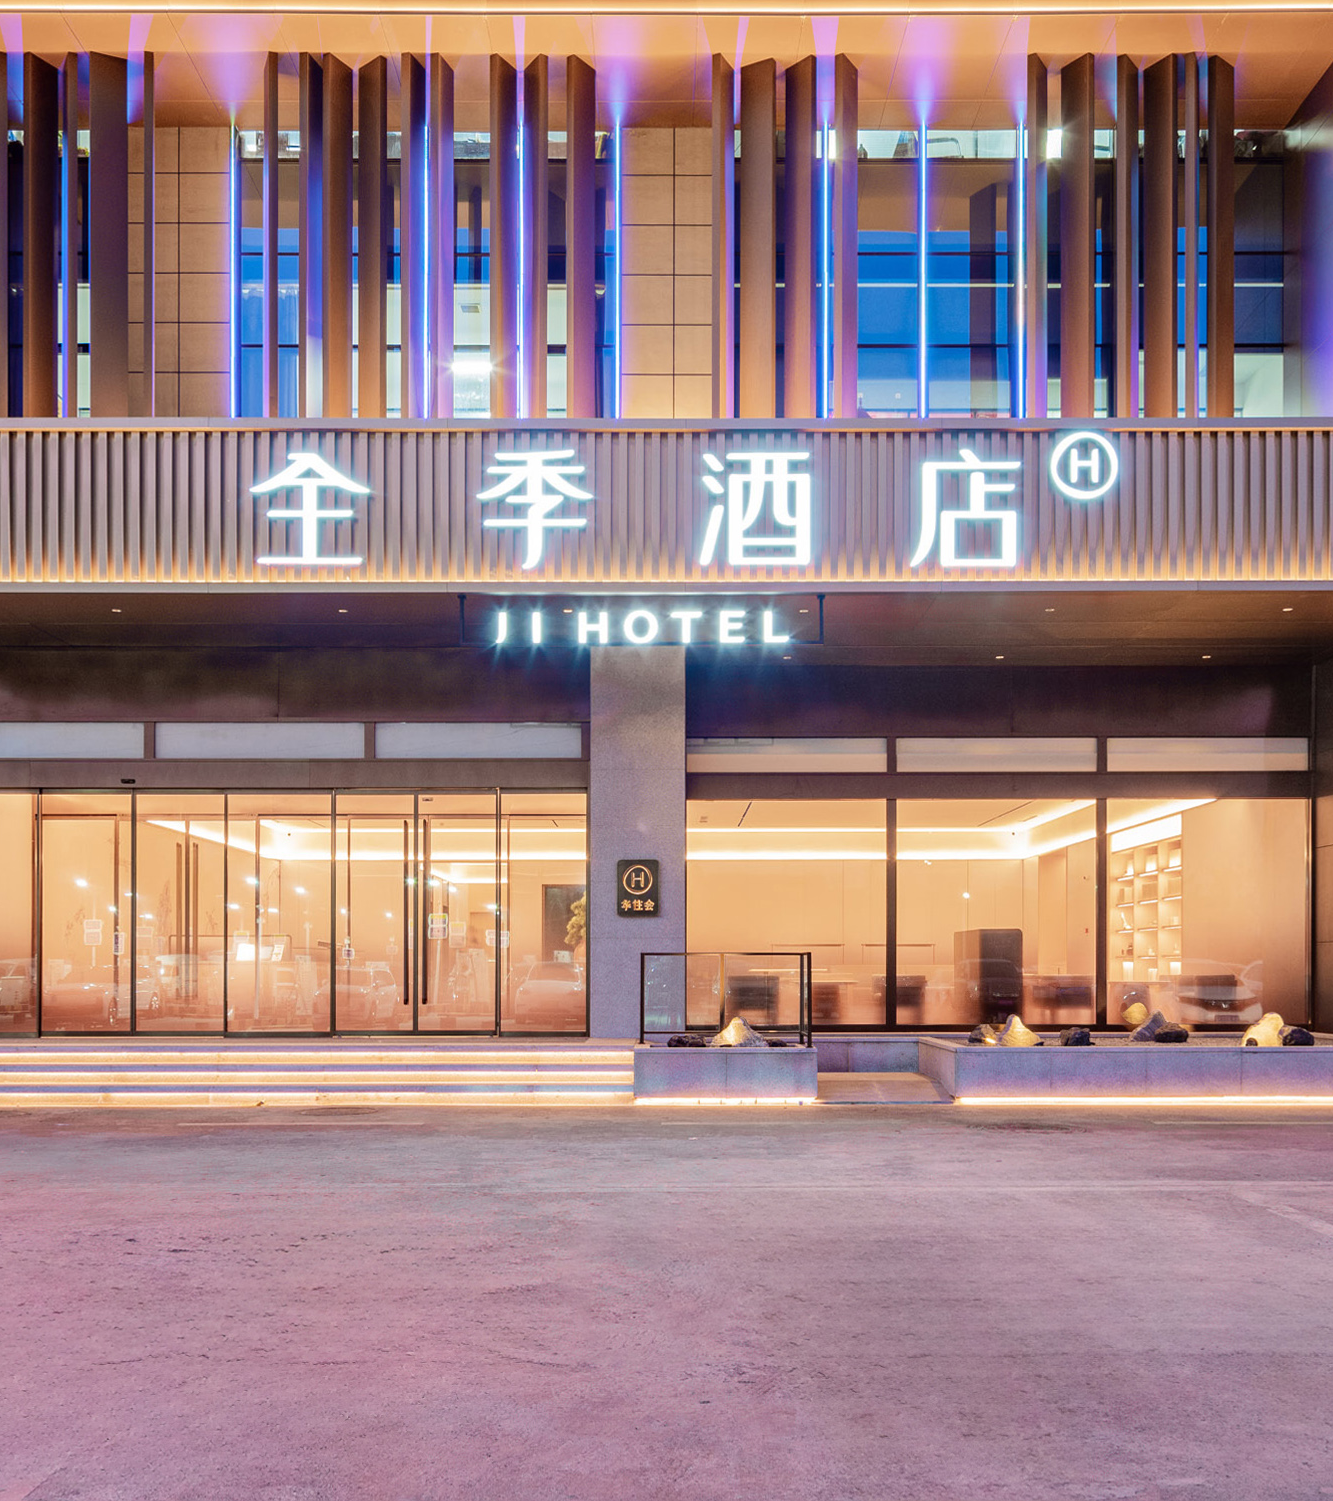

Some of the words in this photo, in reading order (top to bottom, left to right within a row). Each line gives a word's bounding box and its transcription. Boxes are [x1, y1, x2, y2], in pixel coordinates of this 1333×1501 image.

[249, 448, 1022, 570] 全季酒店
[494, 609, 544, 645] JI
[577, 609, 792, 645] HOTEL
[621, 899, 655, 911] 华住会
